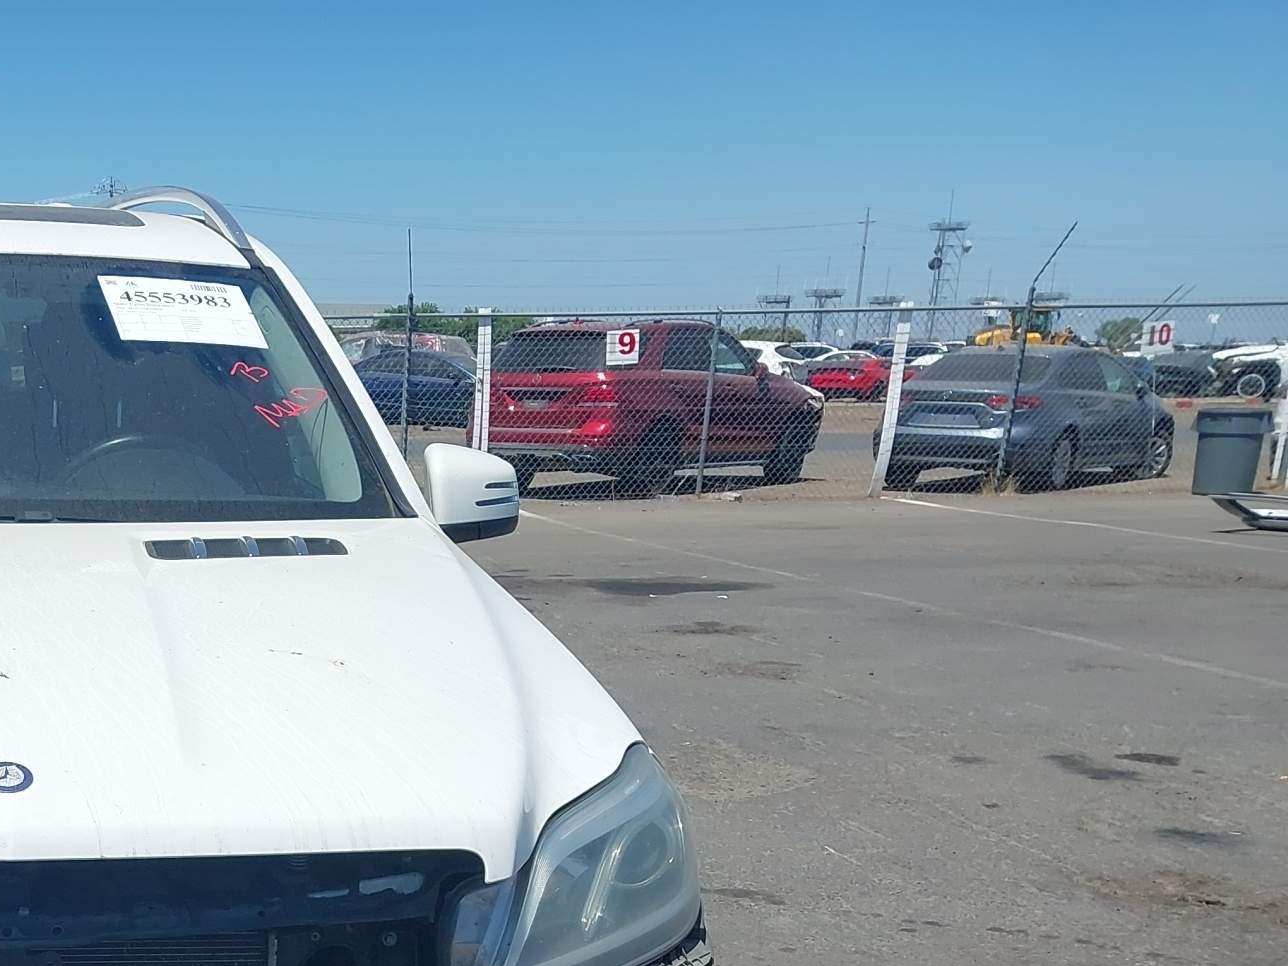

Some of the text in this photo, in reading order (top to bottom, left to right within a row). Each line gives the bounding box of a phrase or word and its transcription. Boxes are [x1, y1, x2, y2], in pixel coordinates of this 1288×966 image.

[119, 290, 231, 308] 45553983
[618, 332, 636, 355] 9
[1148, 323, 1171, 346] 10
